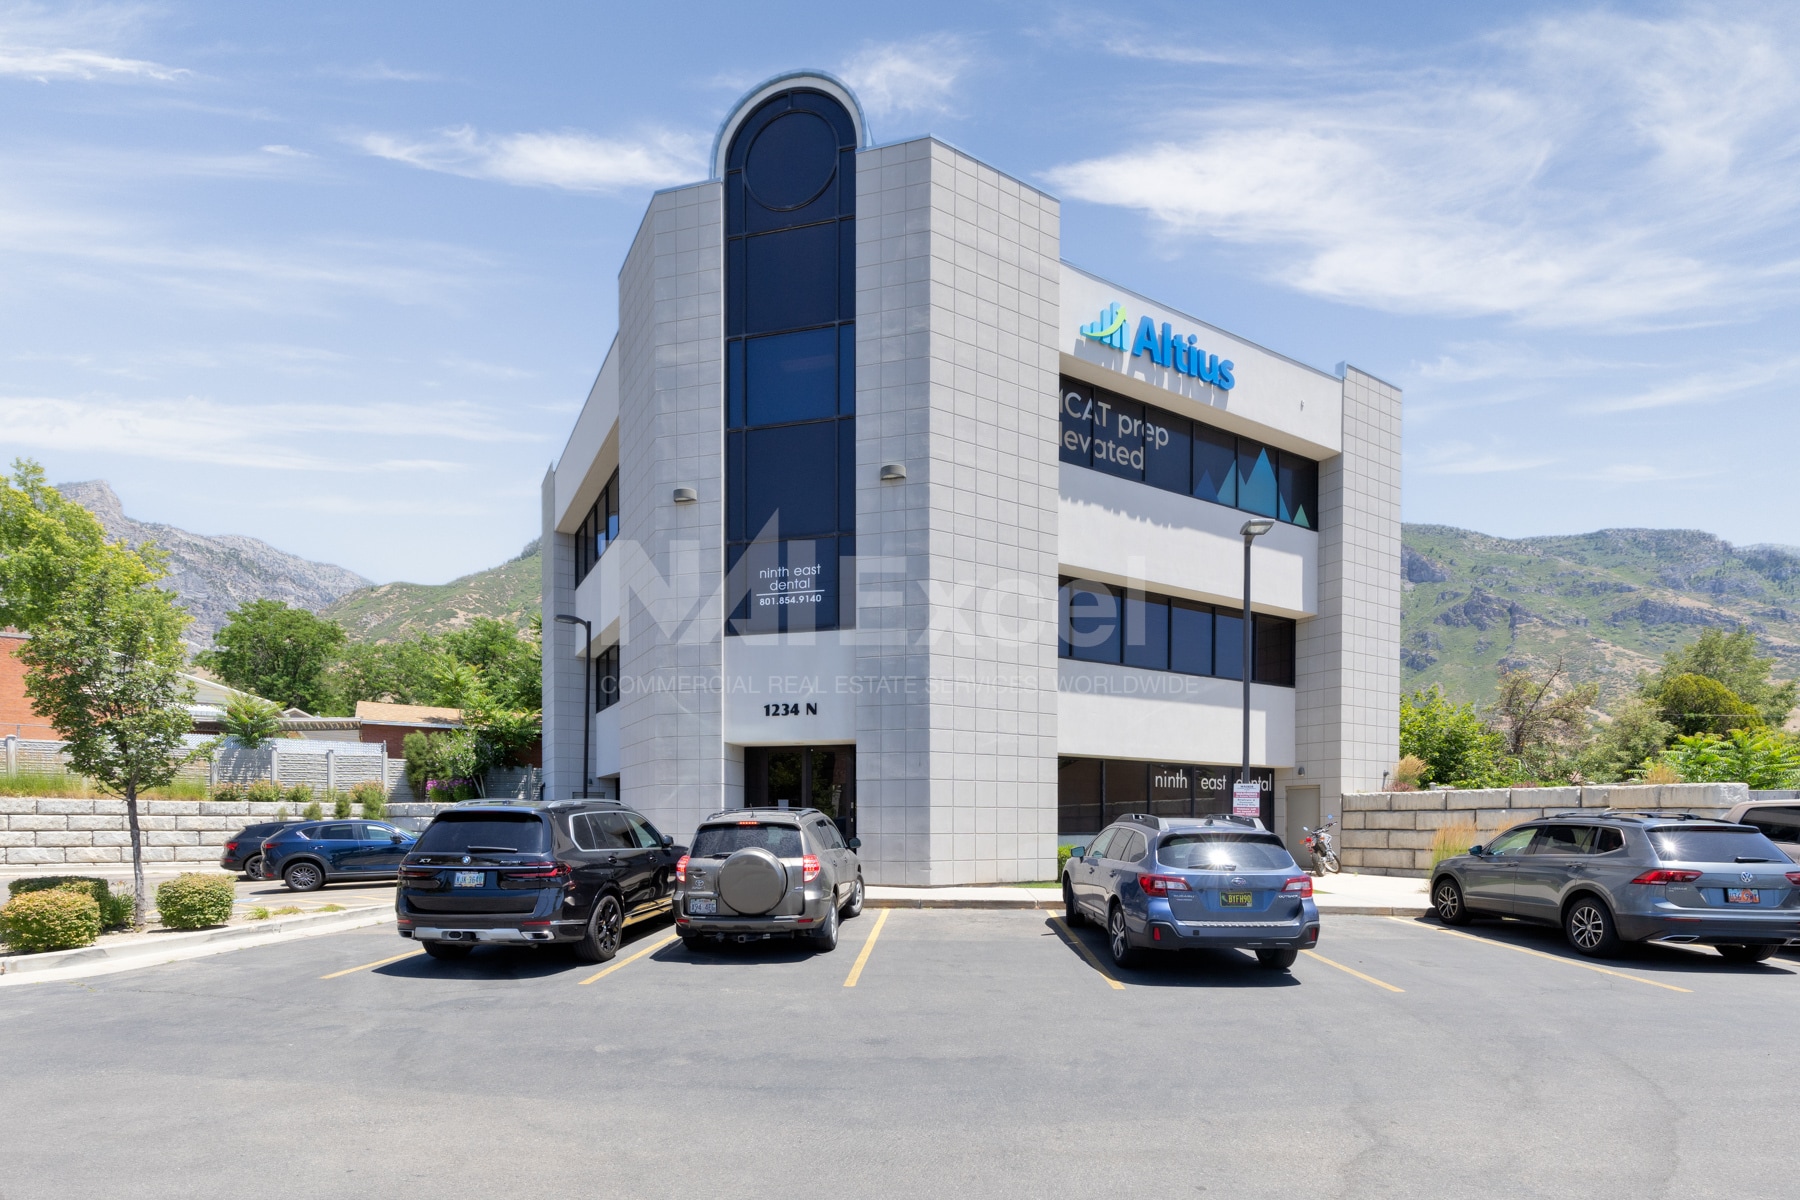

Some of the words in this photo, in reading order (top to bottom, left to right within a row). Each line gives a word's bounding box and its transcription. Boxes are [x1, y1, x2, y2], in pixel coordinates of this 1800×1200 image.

[1132, 315, 1236, 391] Altius
[1058, 388, 1112, 428] CAT
[1118, 413, 1169, 450] prep
[1058, 421, 1144, 471] levated
[759, 566, 790, 579] ninth
[793, 563, 822, 576] east
[769, 577, 810, 591] dental
[759, 594, 822, 606] 801.854.9140
[763, 703, 800, 717] 1234
[805, 702, 818, 716] N
[1154, 769, 1188, 789] ninth
[1200, 774, 1227, 791] east
[1235, 771, 1272, 791] dtal
